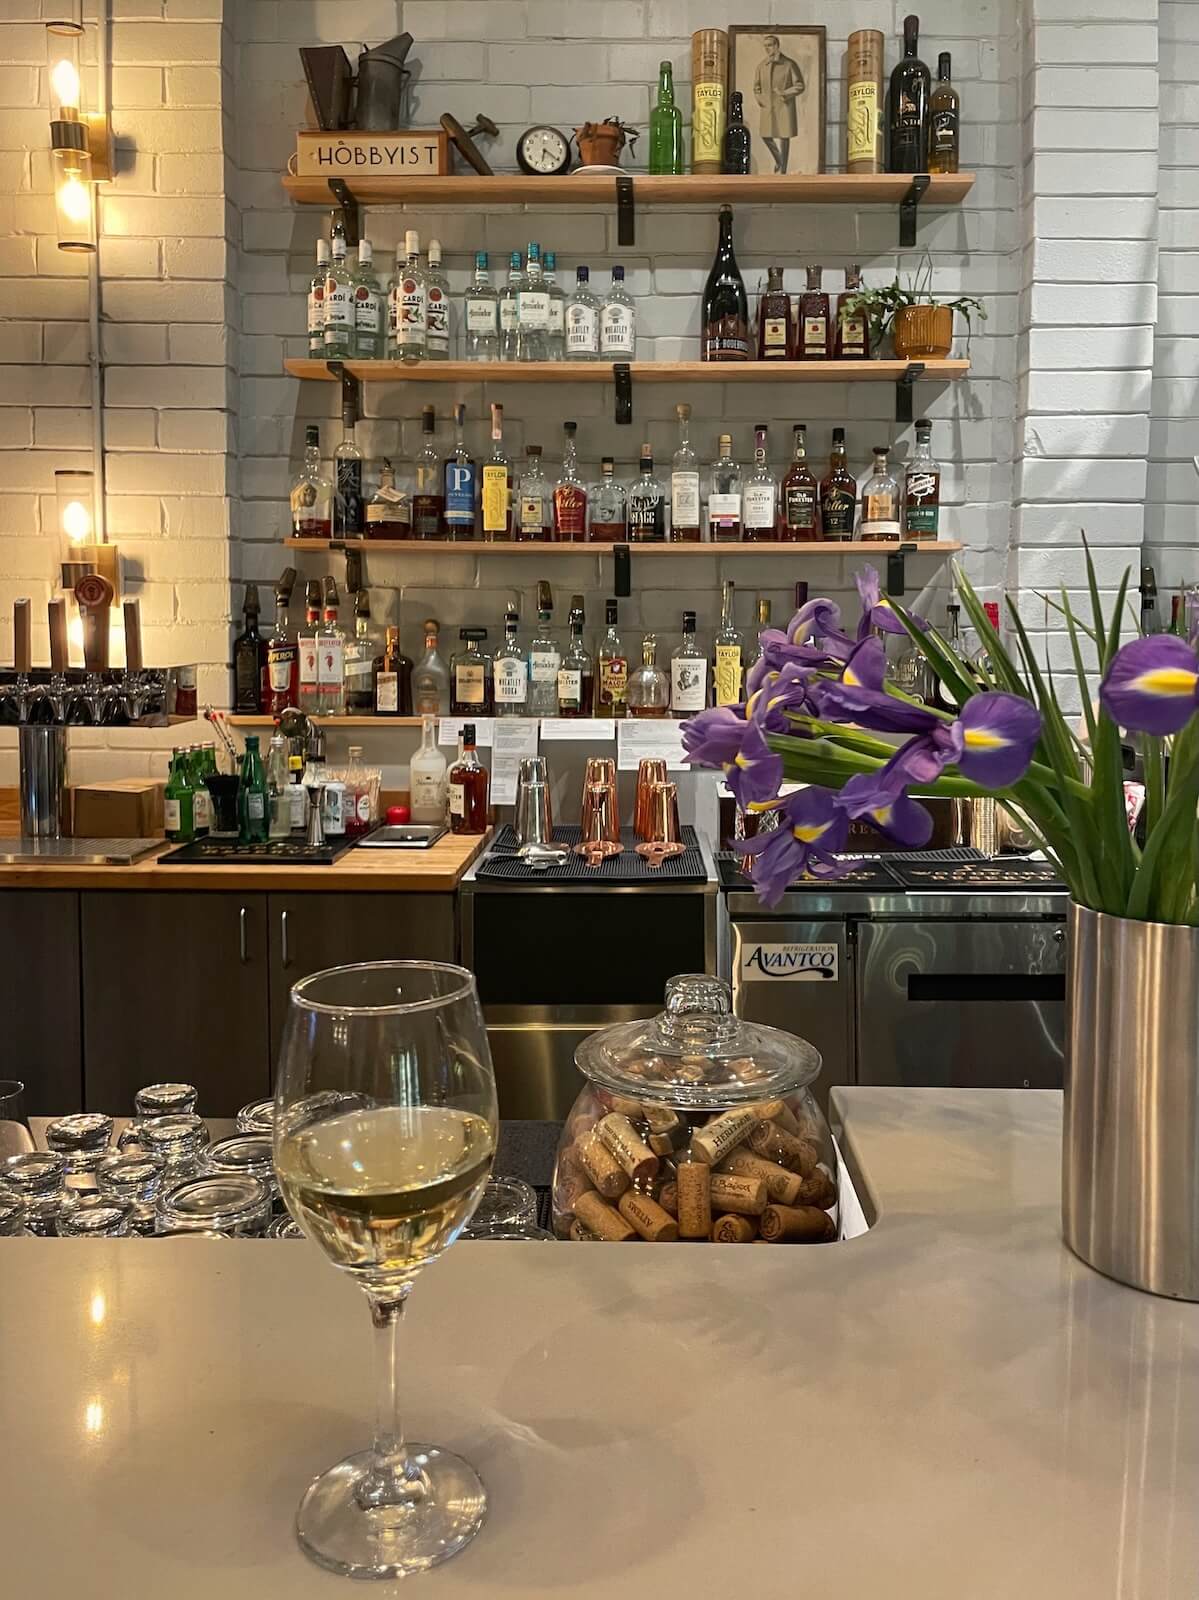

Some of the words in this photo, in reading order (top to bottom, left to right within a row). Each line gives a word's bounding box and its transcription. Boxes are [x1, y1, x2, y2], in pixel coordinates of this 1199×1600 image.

[697, 90, 721, 98] TAYLOR
[850, 87, 876, 98] TAYLOR
[318, 146, 437, 165] HOBBYIST
[453, 468, 471, 491] P
[631, 511, 655, 524] STAGG
[744, 946, 835, 973] AVANTCO
